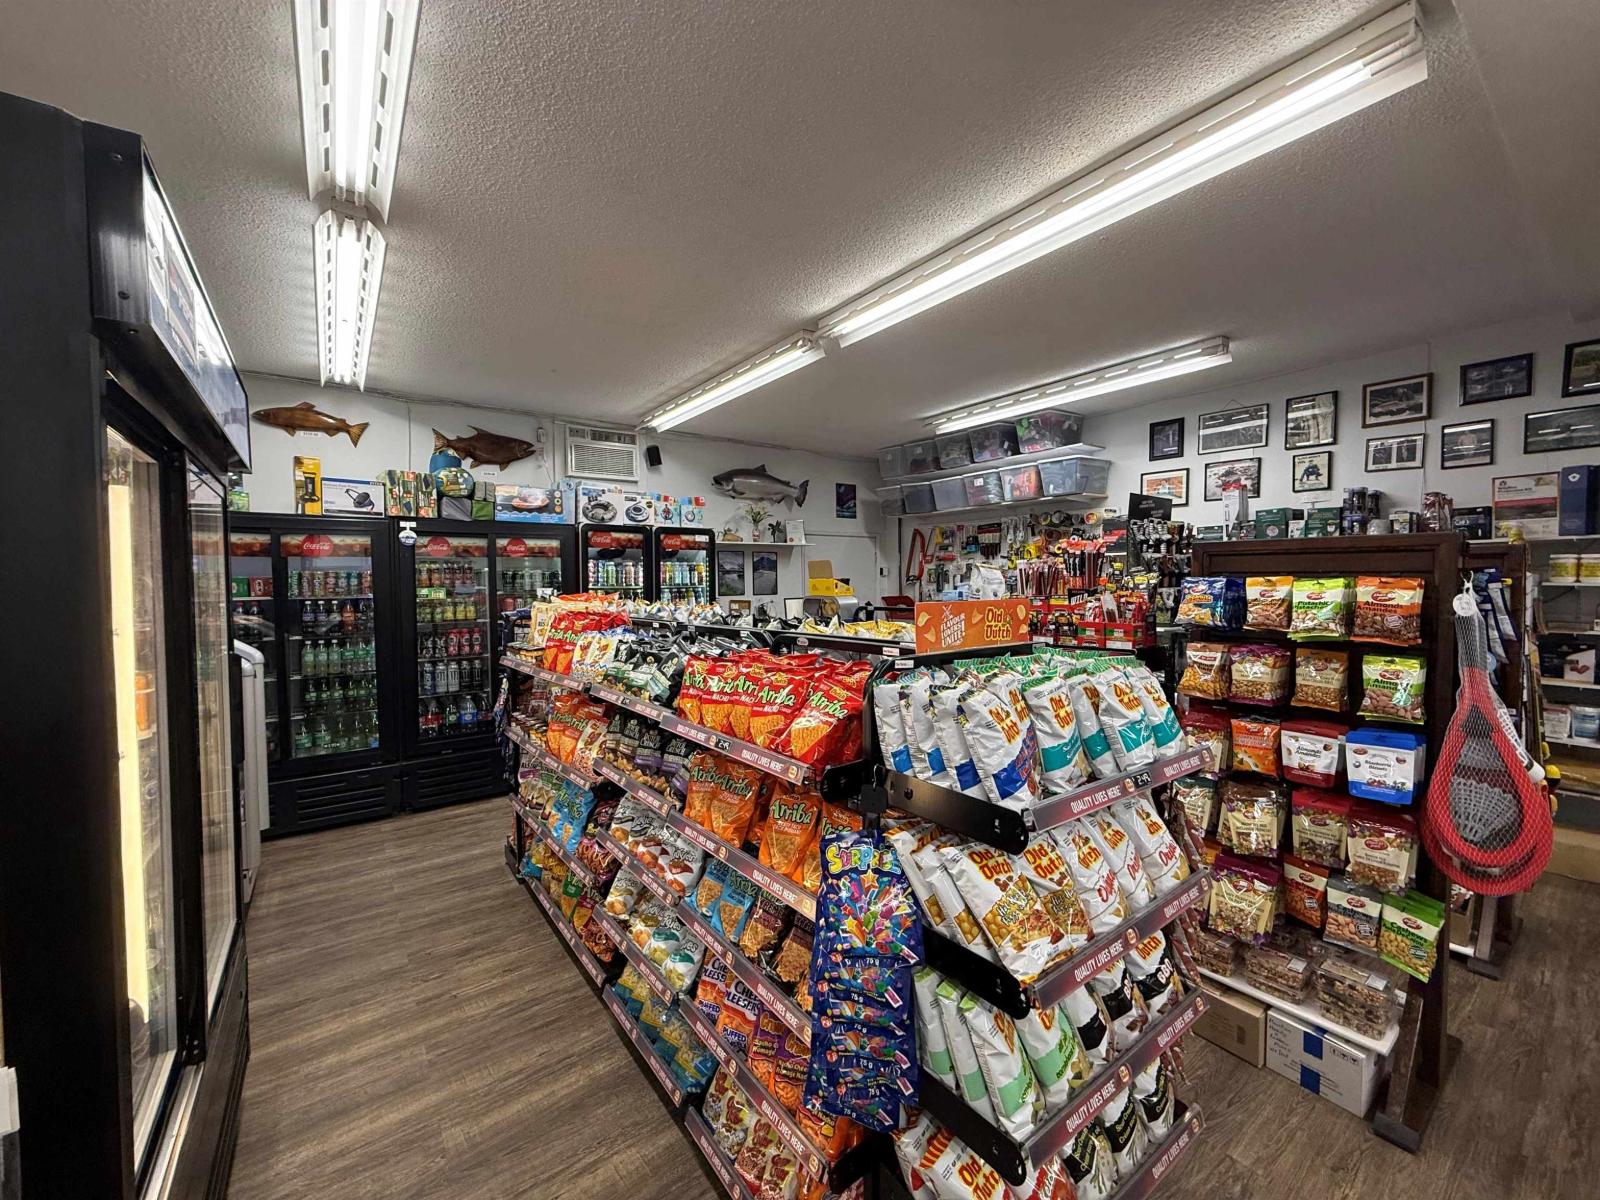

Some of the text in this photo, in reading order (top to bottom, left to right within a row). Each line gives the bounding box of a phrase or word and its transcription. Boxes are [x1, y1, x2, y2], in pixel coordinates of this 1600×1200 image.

[303, 541, 330, 550] Coca-Cola
[427, 543, 448, 551] Coca-Cola
[985, 606, 1004, 624] Old
[1364, 600, 1404, 609] Almonds
[941, 612, 965, 630] FLAVOUR
[984, 623, 1011, 640] Dutch
[758, 685, 796, 706] Arriba
[810, 691, 849, 719] Arriba
[1048, 693, 1066, 713] Old
[741, 750, 784, 772] QUALITY LIVES HERE
[1163, 756, 1200, 777] QUALITY LIVES HERE
[770, 799, 812, 824] Arriba
[1070, 785, 1121, 814] QUALITY LIVES HERE
[968, 849, 994, 865] Old
[1023, 843, 1049, 866] Old
[979, 860, 1014, 881] Dutch
[752, 869, 798, 903] QUALITY LIVES HERE
[1164, 901, 1180, 918] QUALITY
[1179, 893, 1190, 908] LIVES
[1188, 887, 1200, 901] HERE
[1135, 935, 1162, 960] Dutch
[1074, 939, 1124, 982] QUALITY LIVES HERE
[1156, 958, 1174, 984] BBQ
[757, 983, 800, 1028] QUALITY LIVES HERE
[722, 1026, 747, 1042] PUFFED
[1157, 1007, 1195, 1047] QUALITY LIVES HERE
[696, 1021, 728, 1060] QUALITY LIVES HERE
[1066, 1079, 1117, 1133] QUALITY LIVES HERE
[761, 1100, 805, 1155] QUALITY LIVES HERE
[1152, 1131, 1190, 1179] QUALITY LIVES HERE
[958, 1155, 982, 1187] Old
